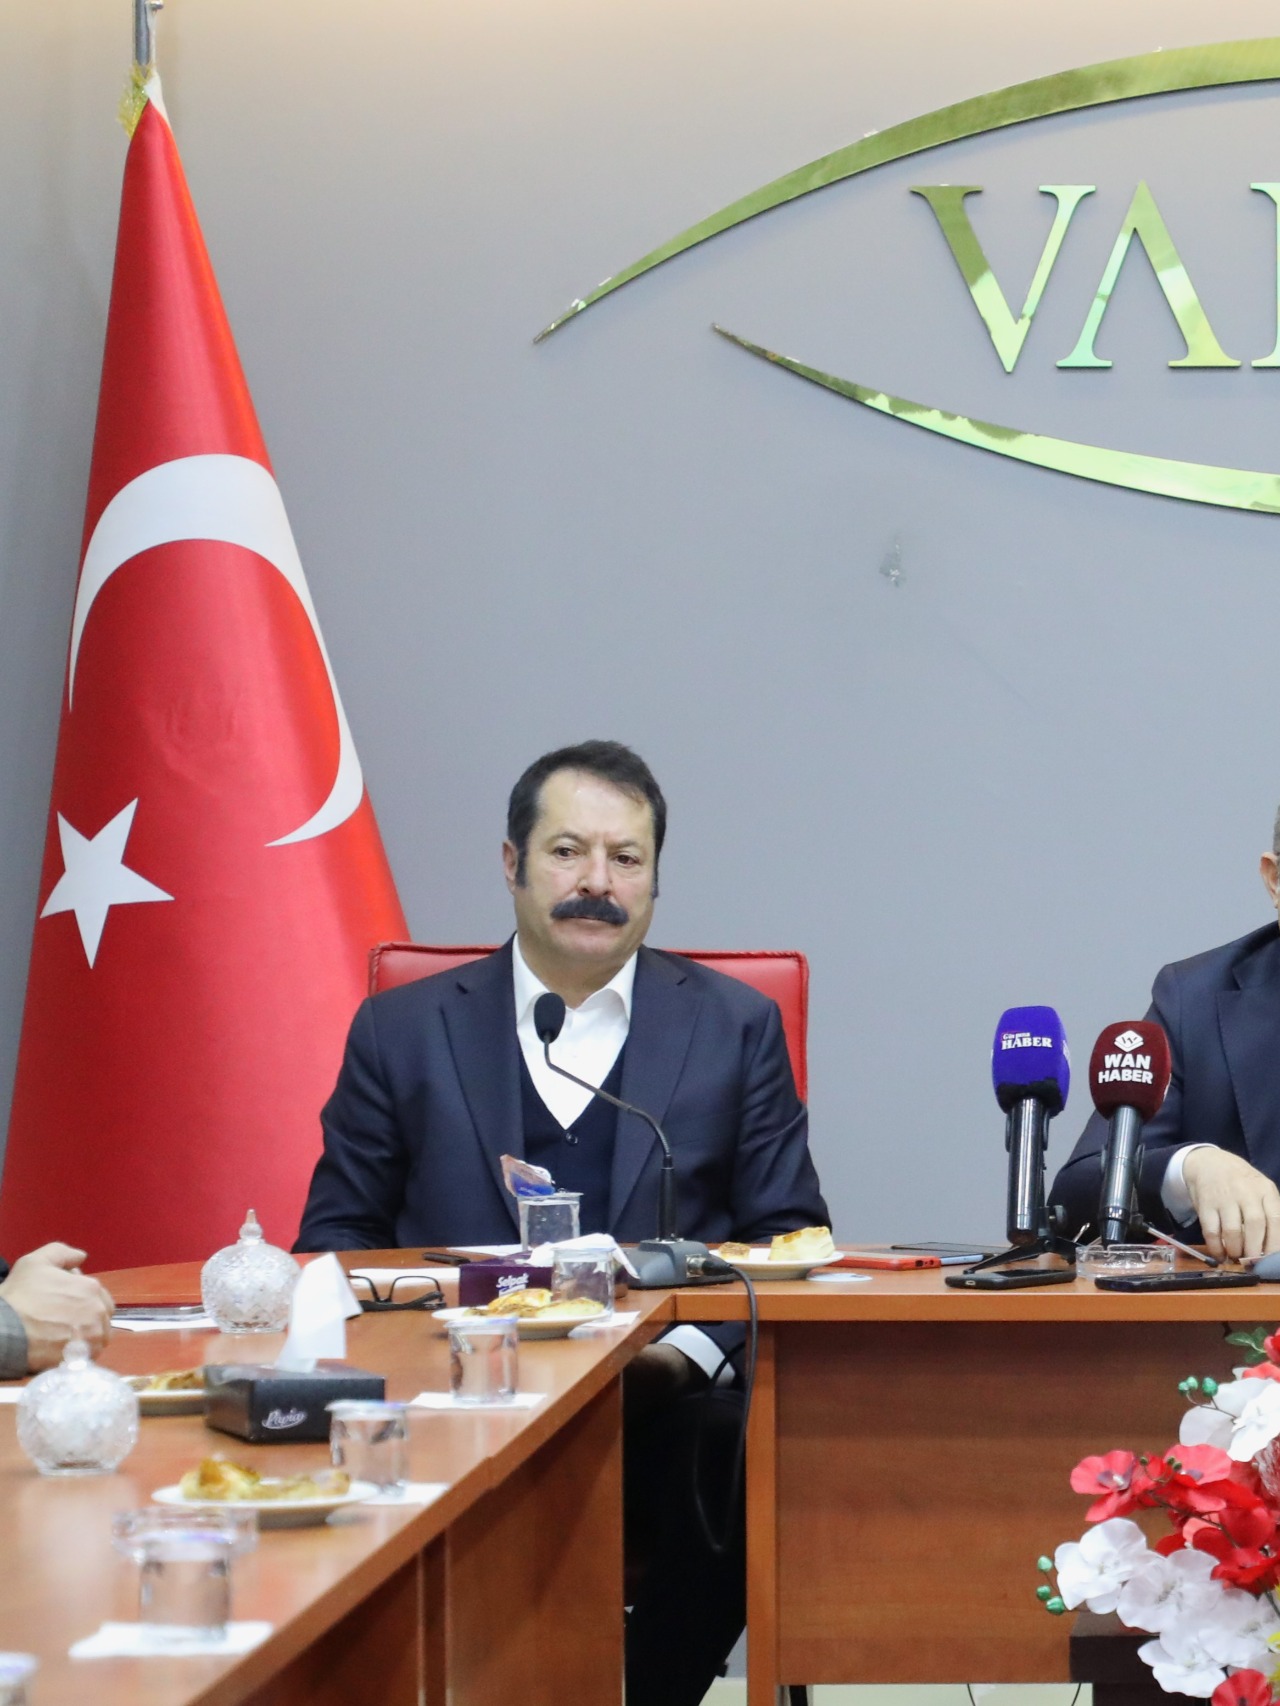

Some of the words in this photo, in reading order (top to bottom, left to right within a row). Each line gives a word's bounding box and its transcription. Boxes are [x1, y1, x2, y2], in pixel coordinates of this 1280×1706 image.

[1001, 1036, 1053, 1050] HABER
[1104, 1053, 1151, 1070] WAN
[1098, 1069, 1154, 1085] HABER
